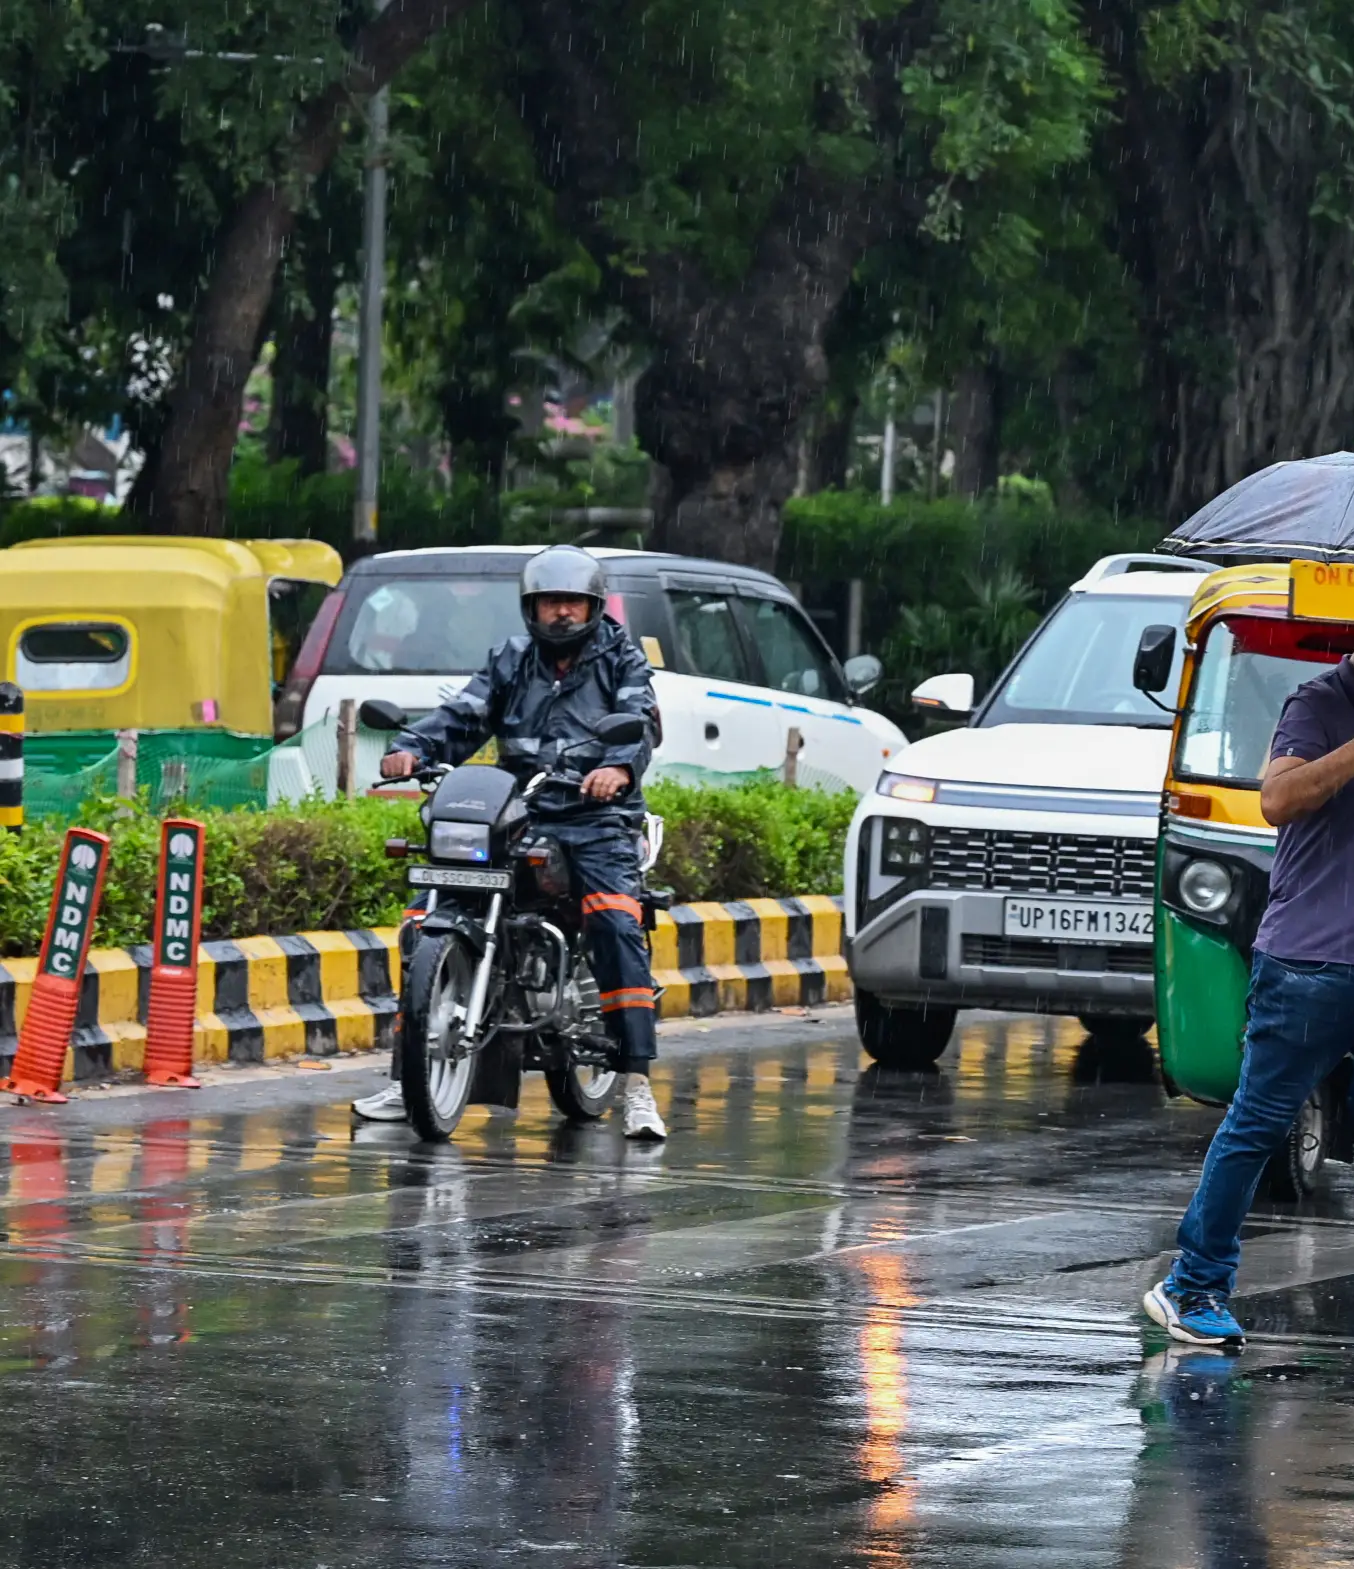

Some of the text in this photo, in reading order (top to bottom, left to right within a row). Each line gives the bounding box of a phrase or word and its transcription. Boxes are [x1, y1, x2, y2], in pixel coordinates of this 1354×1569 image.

[1314, 566, 1341, 586] ON
[51, 881, 88, 973] NDMC
[165, 872, 191, 961] NDMC
[1019, 906, 1154, 935] UP16FM1342
